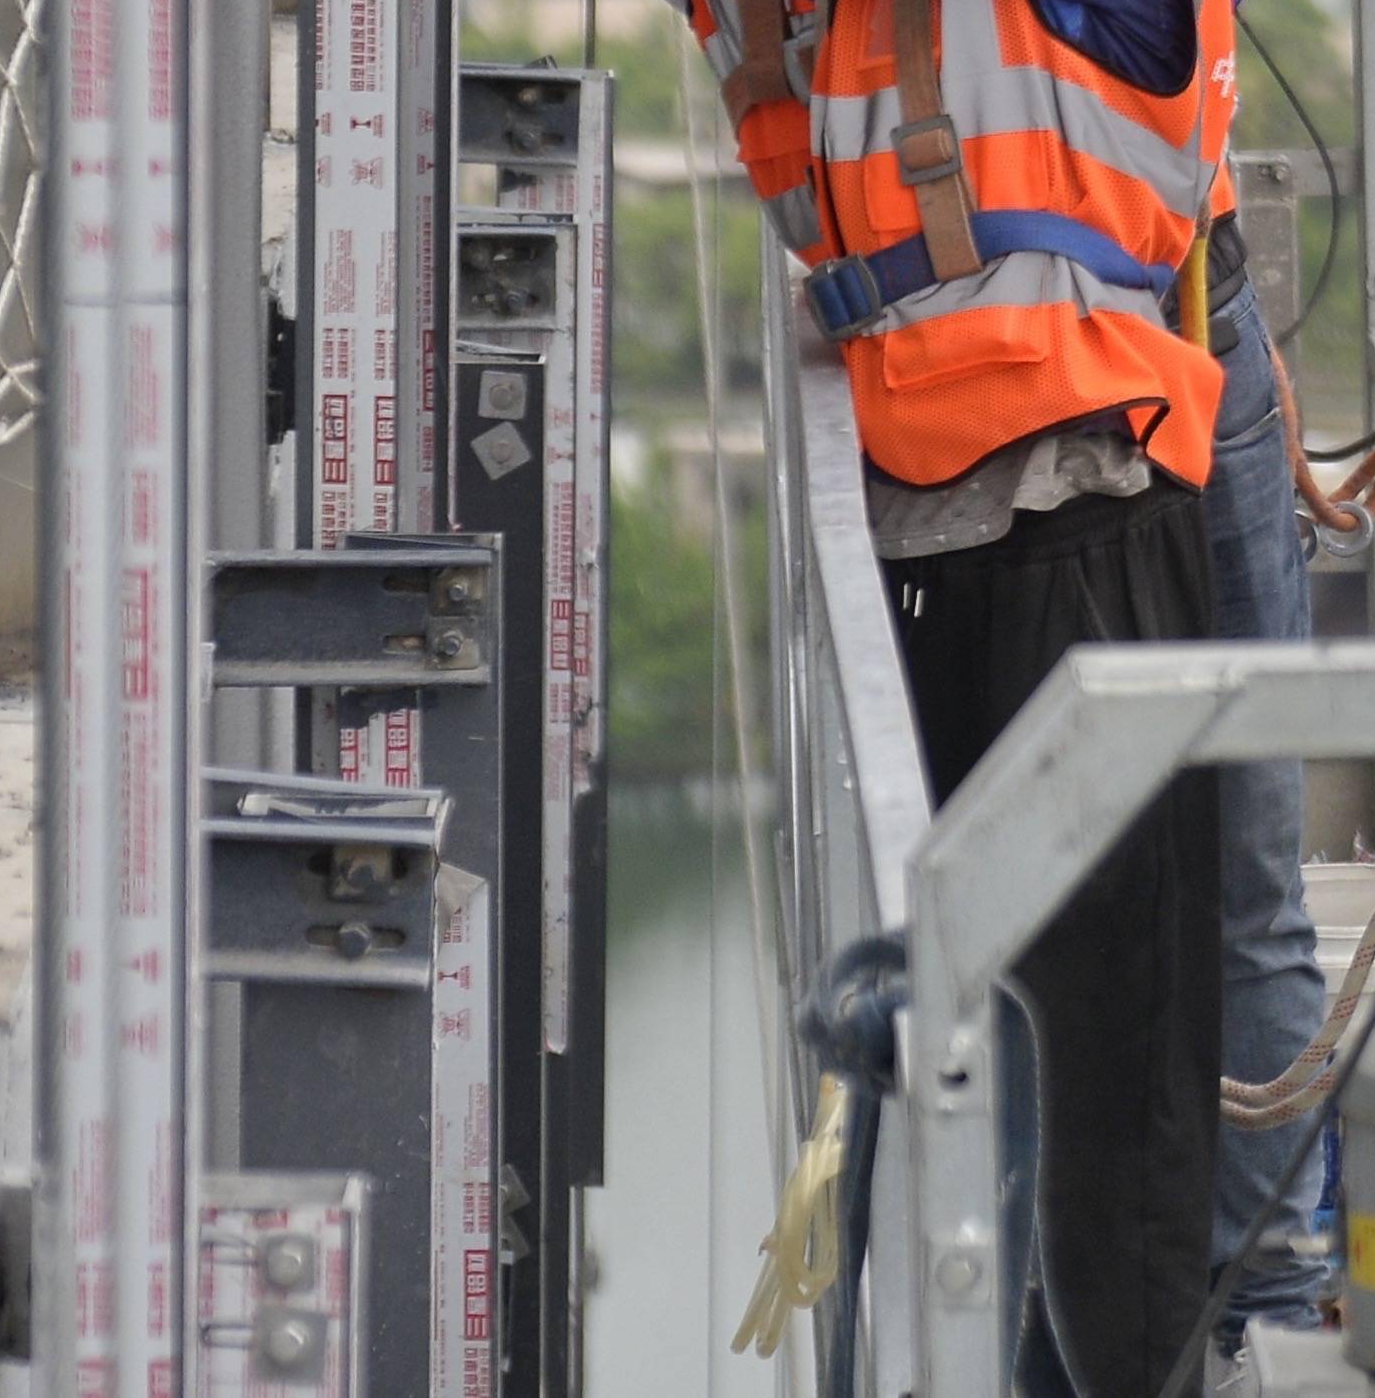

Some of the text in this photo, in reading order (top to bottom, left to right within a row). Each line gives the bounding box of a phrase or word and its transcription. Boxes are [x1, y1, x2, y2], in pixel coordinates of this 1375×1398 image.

[324, 396, 346, 482] 三星铝材
[466, 1252, 488, 1339] 三星铝材
